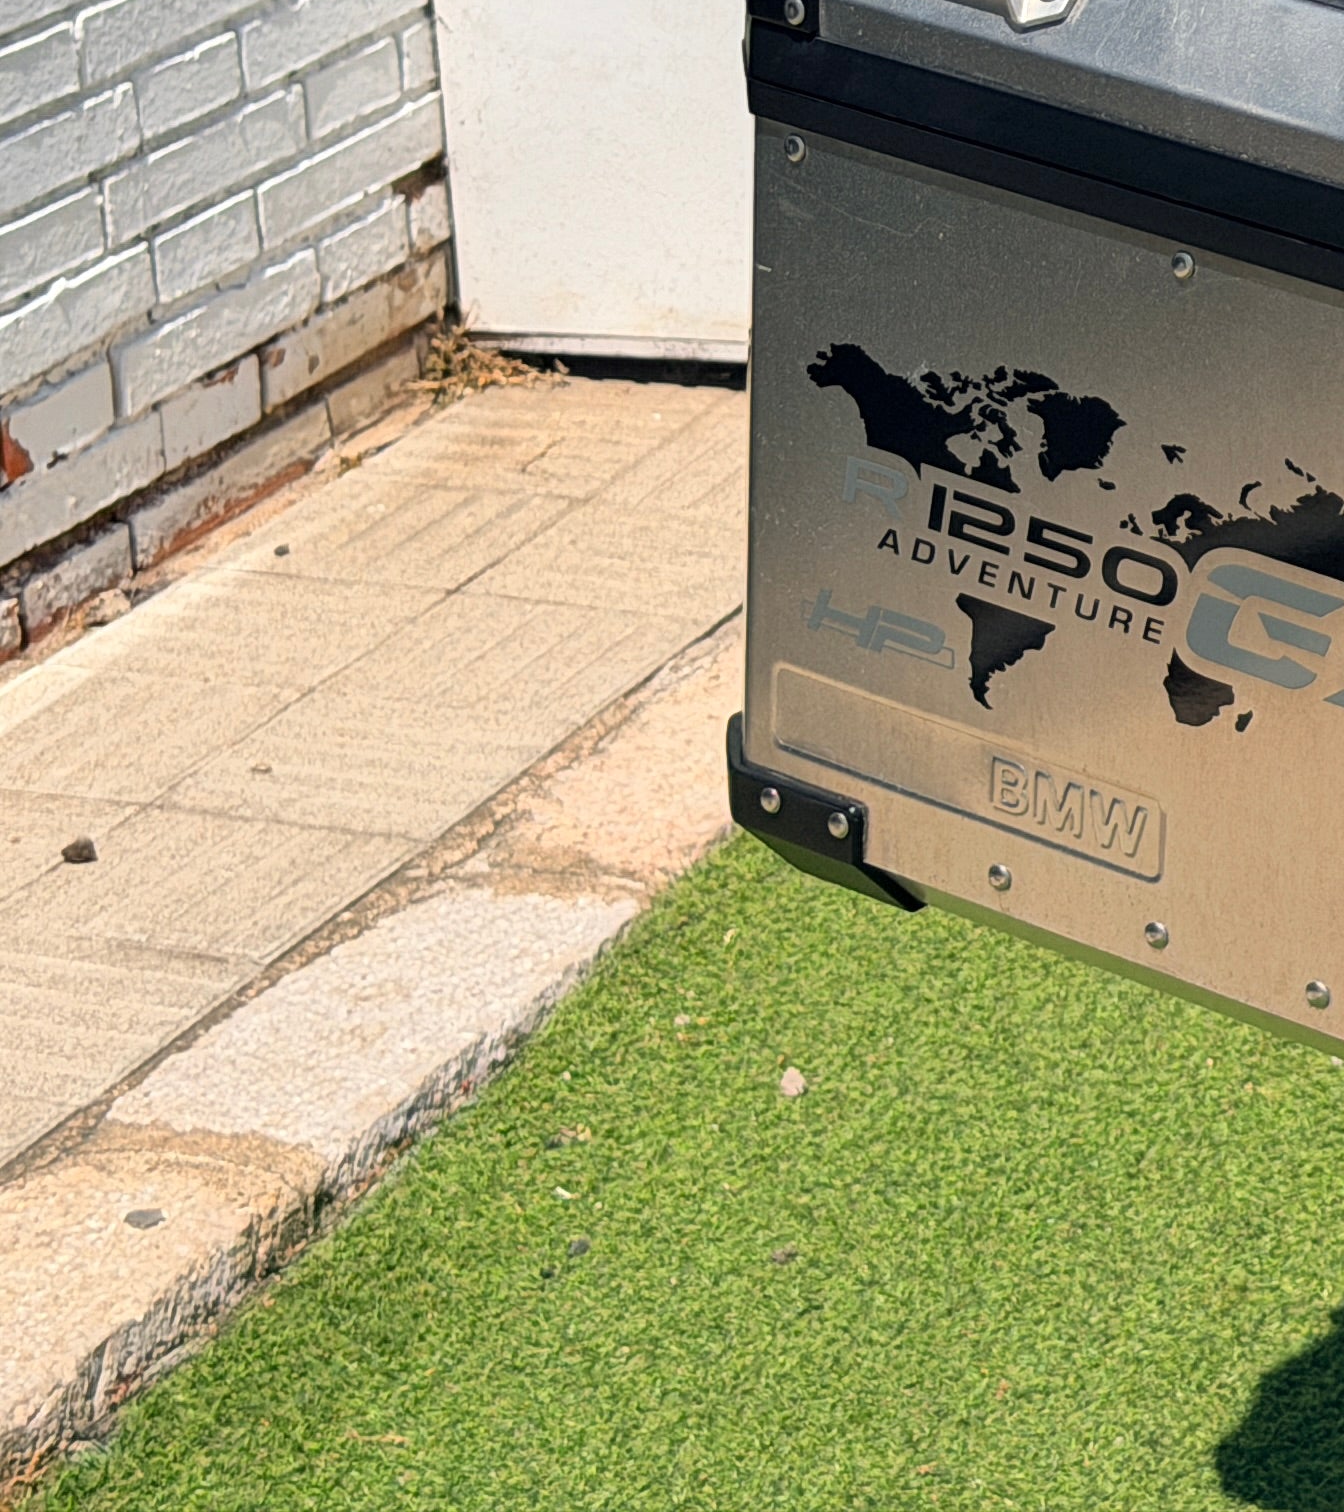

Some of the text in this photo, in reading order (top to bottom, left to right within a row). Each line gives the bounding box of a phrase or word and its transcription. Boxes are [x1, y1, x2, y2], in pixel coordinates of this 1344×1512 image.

[842, 455, 909, 520] R
[927, 482, 1179, 608] 1250
[876, 527, 1166, 645] ADVENTURE
[988, 754, 1156, 859] BMW
